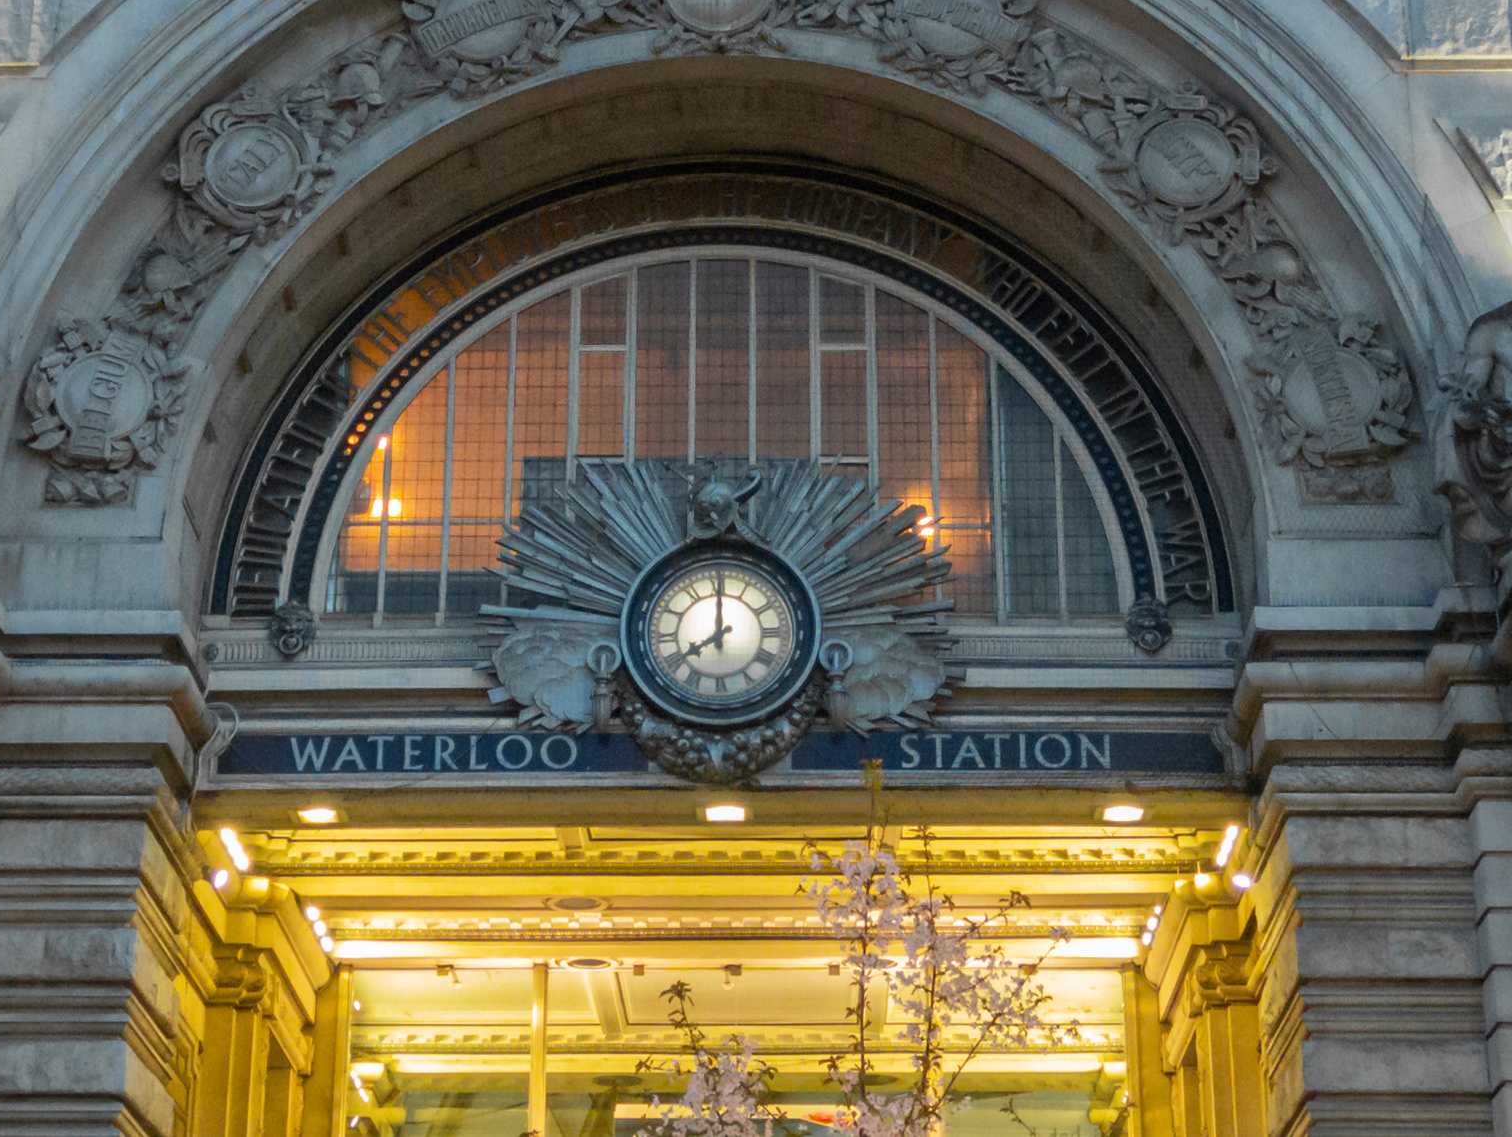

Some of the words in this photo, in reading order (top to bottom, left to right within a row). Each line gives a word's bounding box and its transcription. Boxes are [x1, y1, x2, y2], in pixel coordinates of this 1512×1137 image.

[958, 242, 1046, 321] WHO
[1030, 298, 1120, 393] FELL
[73, 339, 143, 451] BELGIUM
[1095, 379, 1152, 434] IN
[1121, 425, 1191, 513] THE
[1153, 514, 1214, 608] WAR
[290, 734, 578, 771] WATERLOO
[900, 732, 1111, 769] STATION
